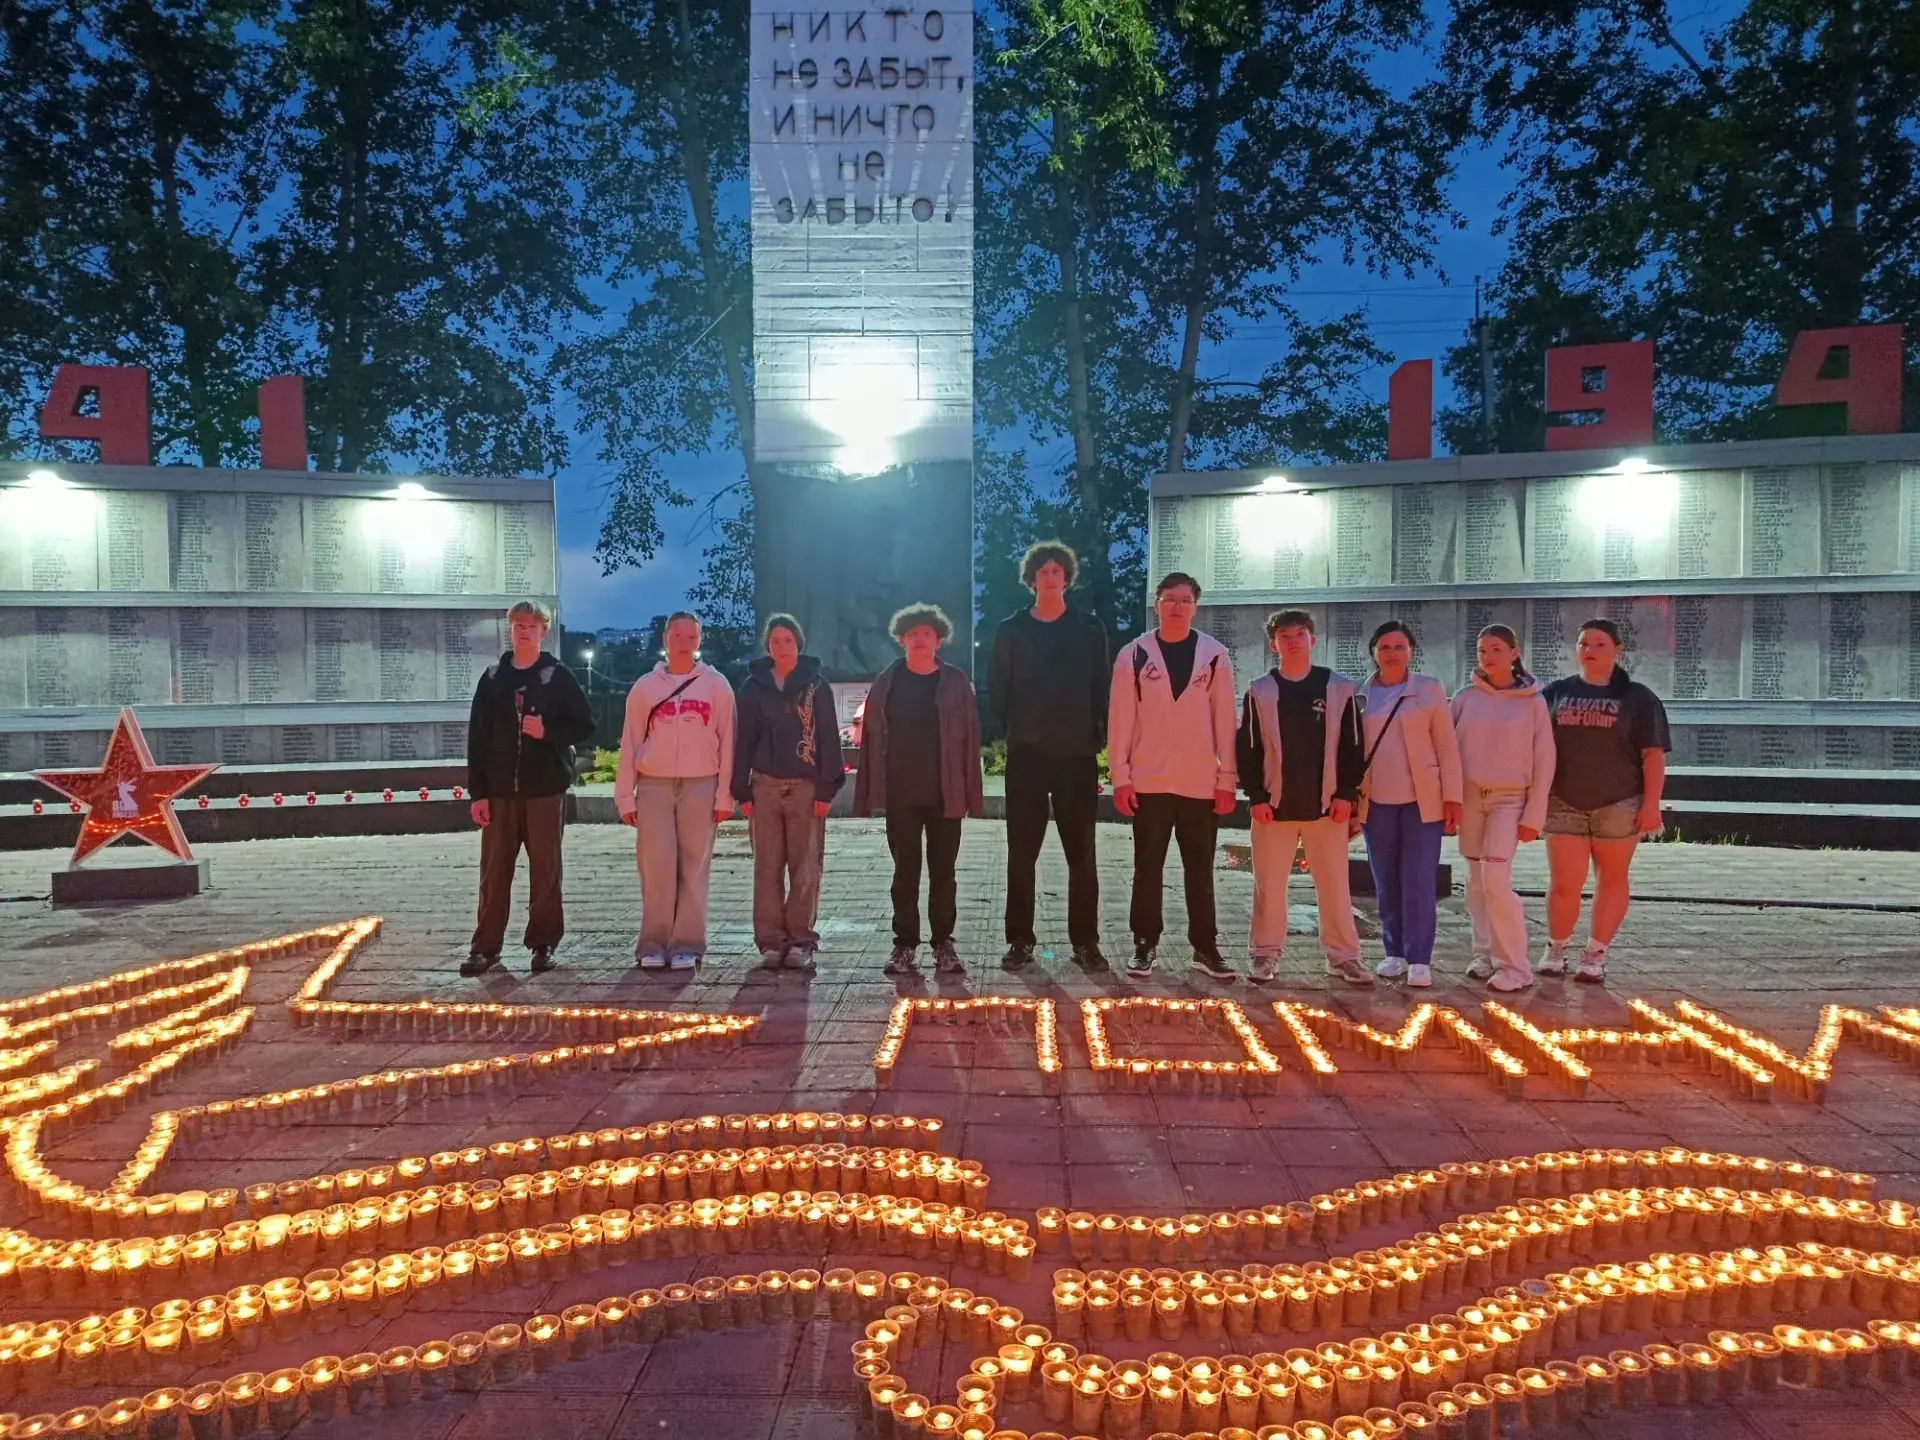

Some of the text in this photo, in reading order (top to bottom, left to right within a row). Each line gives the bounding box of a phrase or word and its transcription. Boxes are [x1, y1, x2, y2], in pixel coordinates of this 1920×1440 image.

[772, 9, 945, 43] НИКТО
[833, 56, 965, 93] ЗАБЫТ,
[773, 104, 935, 136] И НИЧТО
[776, 183, 953, 225] ЗАБЫТО!
[1557, 696, 1620, 714] ALWAYS
